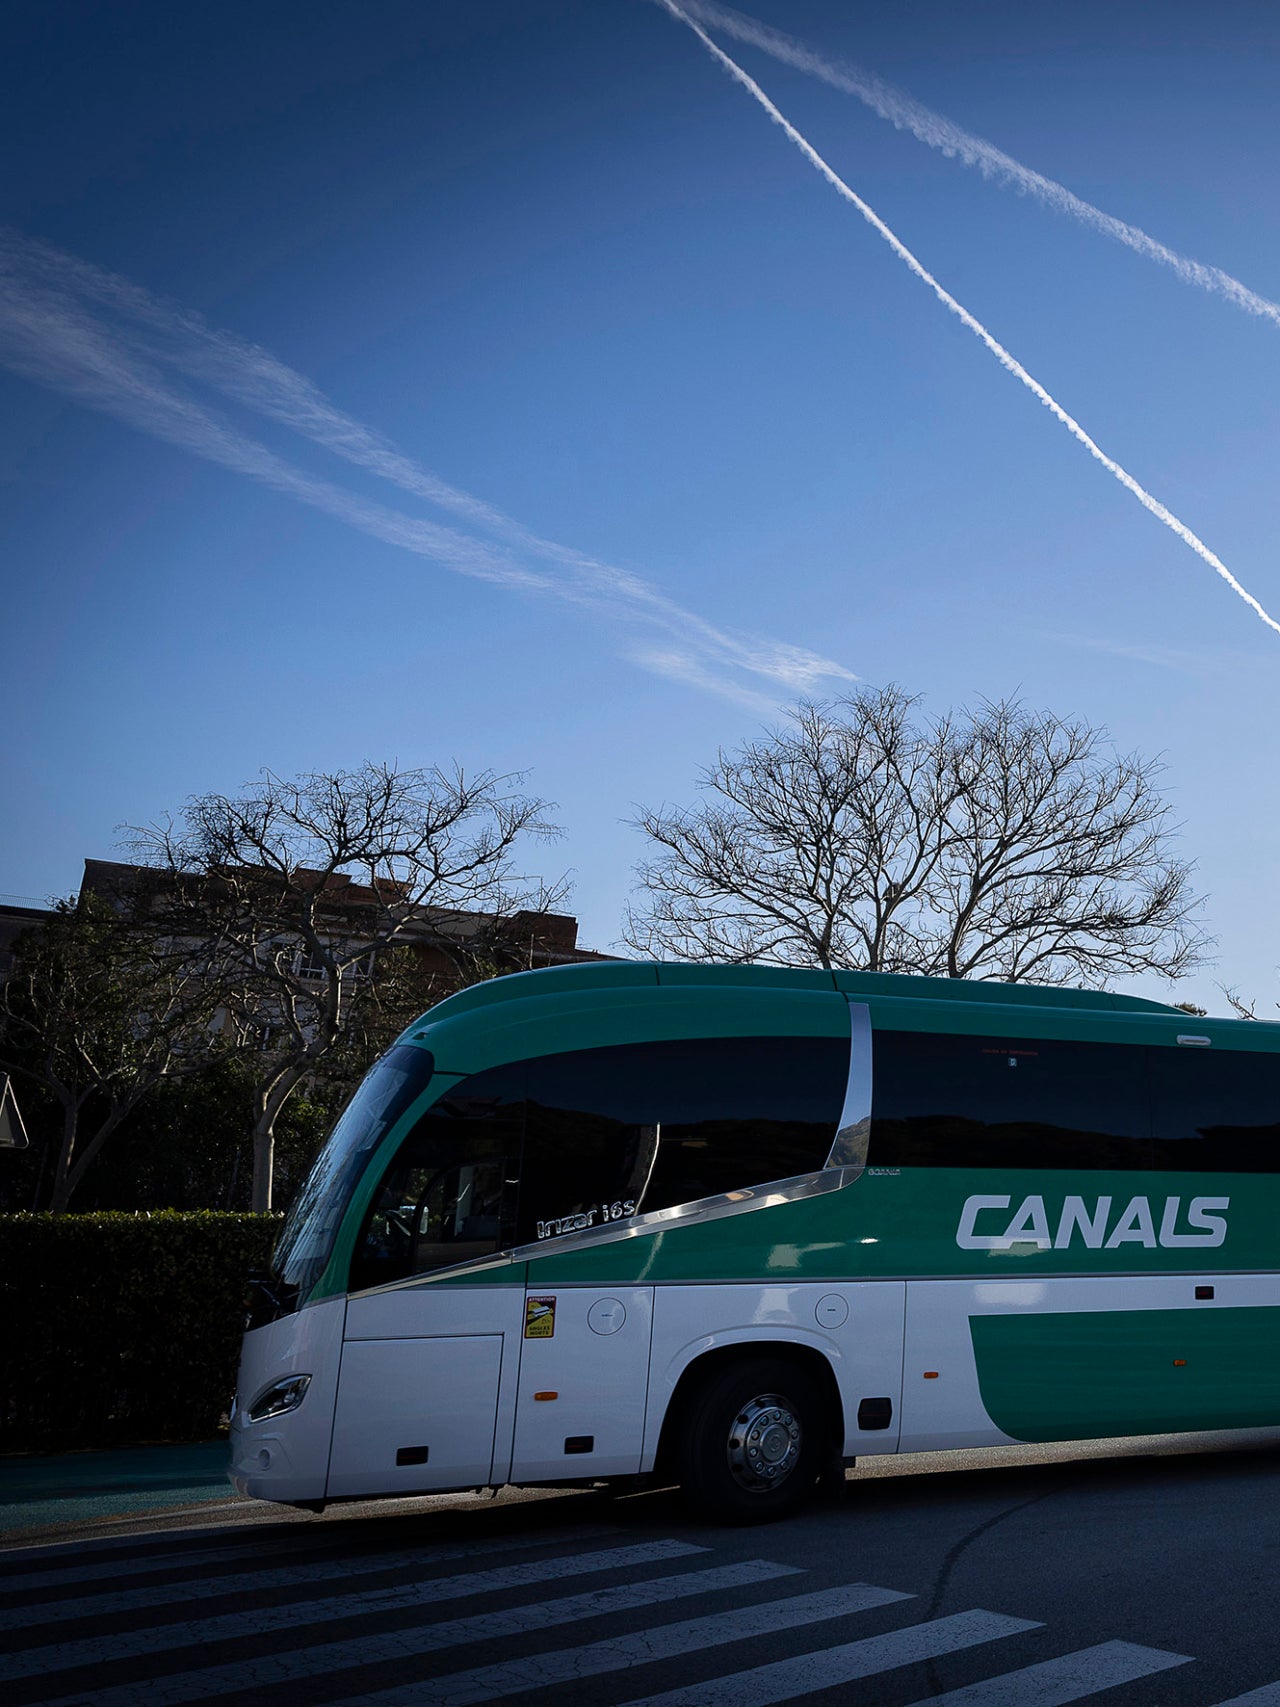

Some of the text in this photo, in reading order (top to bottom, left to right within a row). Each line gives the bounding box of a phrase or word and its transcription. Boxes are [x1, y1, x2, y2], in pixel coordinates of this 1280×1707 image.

[536, 1199, 635, 1239] Irizar i6s
[955, 1194, 1231, 1250] CANALS
